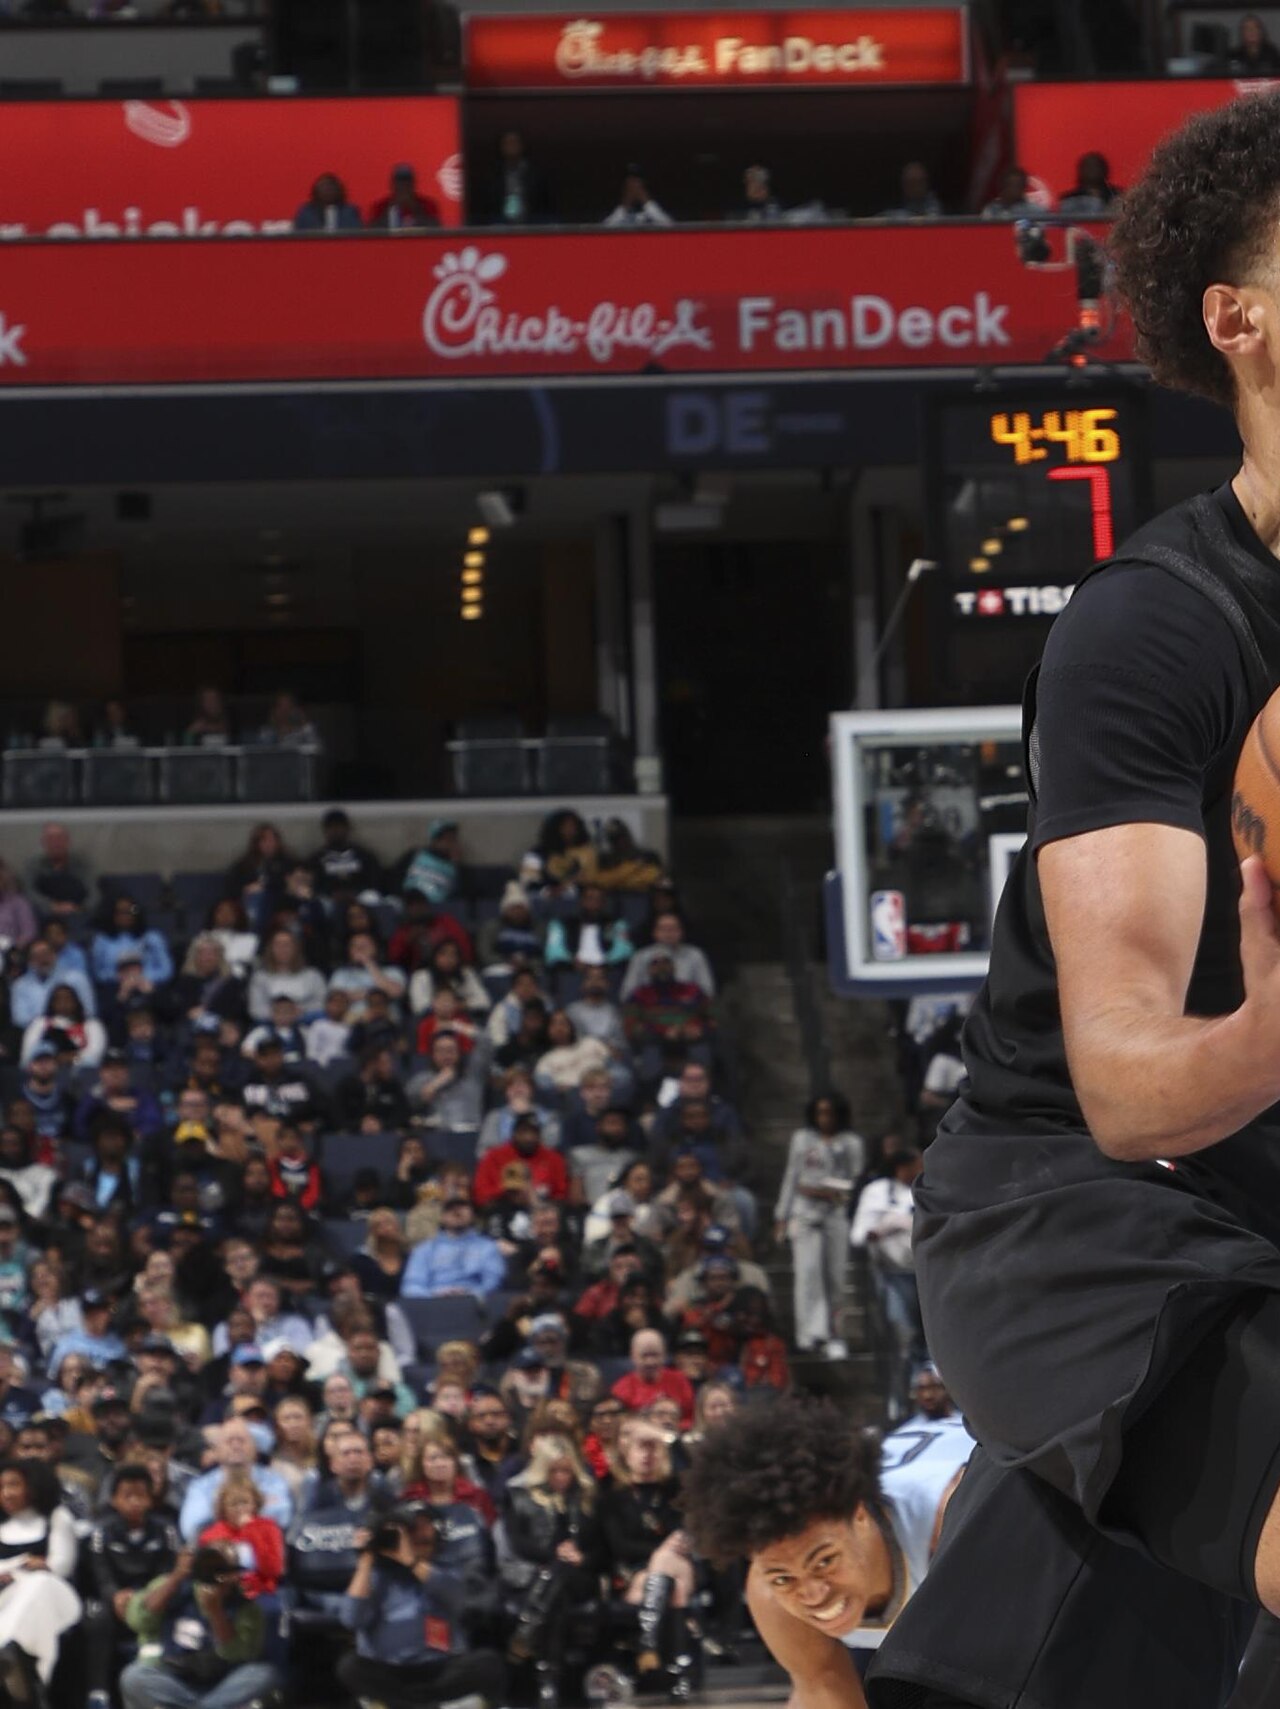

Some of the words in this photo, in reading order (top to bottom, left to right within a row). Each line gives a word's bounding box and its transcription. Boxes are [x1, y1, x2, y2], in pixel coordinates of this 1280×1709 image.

[715, 37, 884, 74] FanDeck
[422, 248, 711, 361] Chick-fil-A
[738, 293, 1009, 349] FanDeck
[990, 408, 1120, 464] 4:46
[1046, 465, 1114, 562] 7
